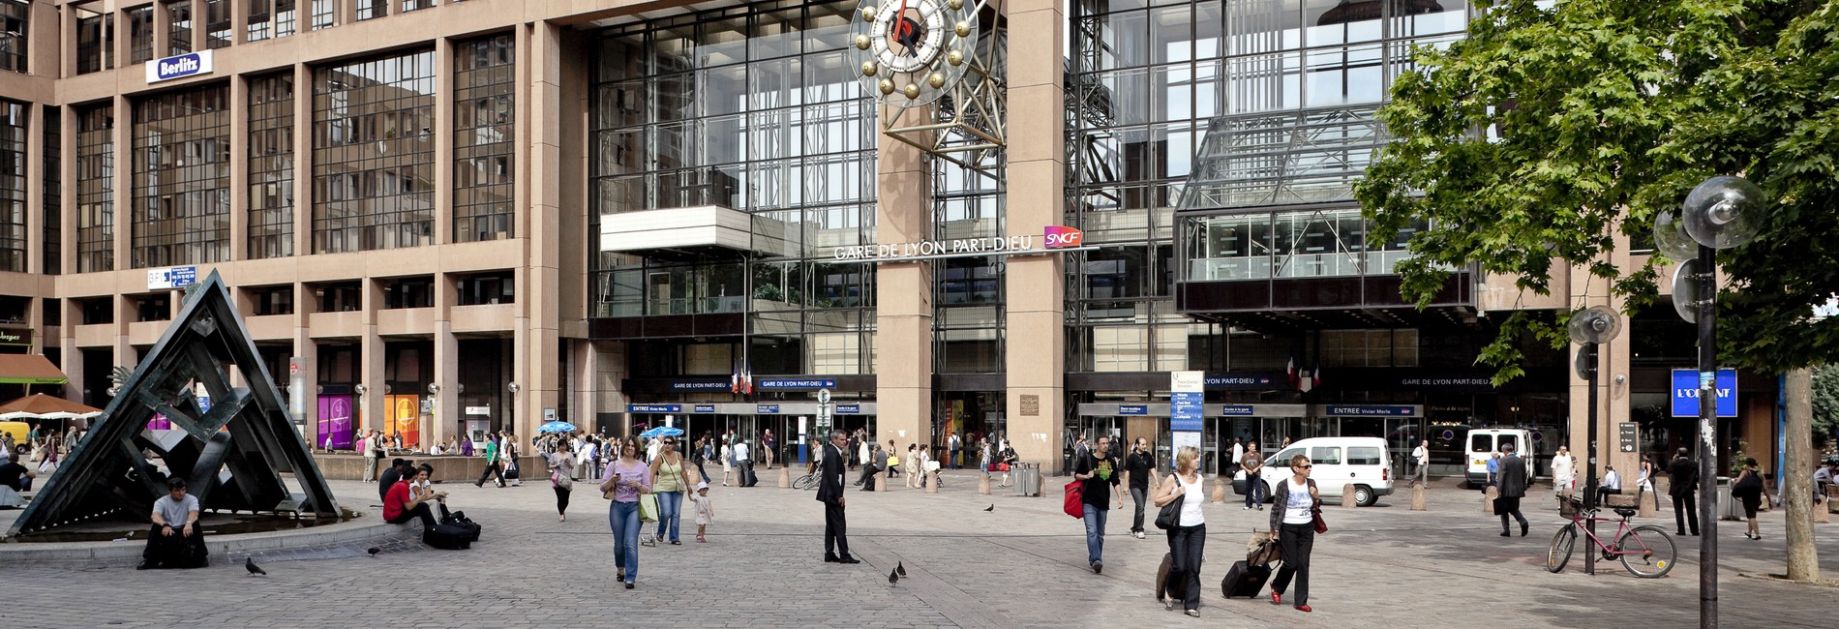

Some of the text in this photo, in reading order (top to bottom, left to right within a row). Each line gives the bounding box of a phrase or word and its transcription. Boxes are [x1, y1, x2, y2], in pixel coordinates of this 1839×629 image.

[161, 58, 198, 76] Berlitz
[834, 236, 1032, 260] GARE DE LYON PART-DIEU
[1046, 232, 1081, 246] SNCF
